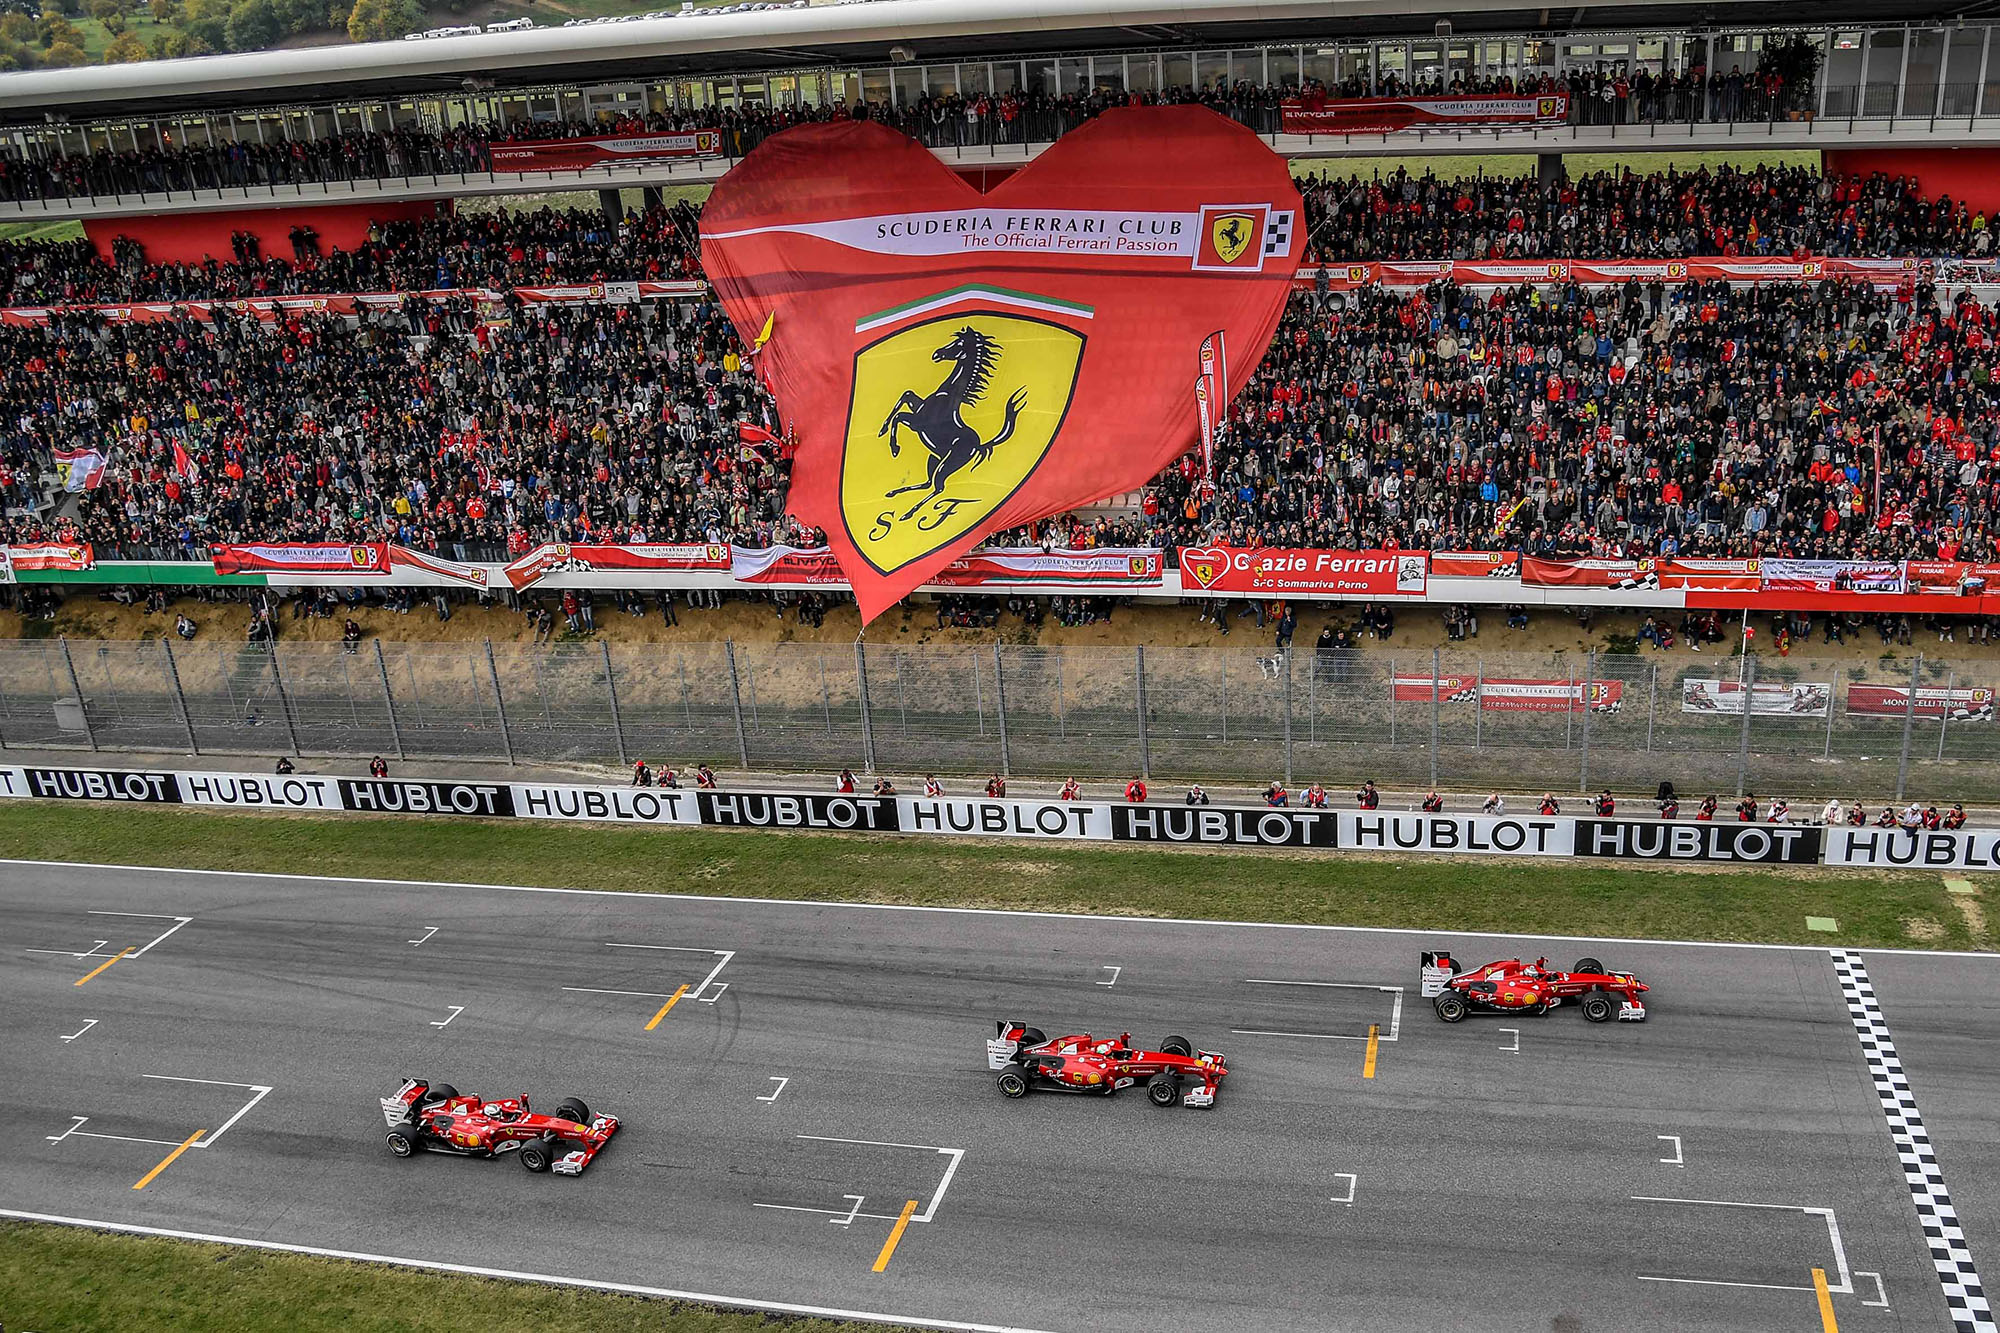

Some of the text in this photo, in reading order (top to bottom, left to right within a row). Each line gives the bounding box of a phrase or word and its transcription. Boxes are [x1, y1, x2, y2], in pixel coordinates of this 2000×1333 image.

[877, 216, 1182, 239] SCUDERIA FERRARI CLUB
[962, 234, 1178, 252] The Official Ferrari Passion
[868, 510, 895, 542] S
[1234, 552, 1396, 574] Gazie Ferrari
[1277, 579, 1334, 589] Sommariva
[1338, 580, 1368, 589] Perno
[1883, 699, 1935, 707] MONTCELLI
[34, 772, 164, 800] HUBLOT
[187, 774, 328, 807] HUBLOT
[350, 783, 498, 814] HUBLOT
[524, 788, 682, 821] HUBLOT
[713, 796, 881, 828] HUBLOT
[912, 802, 1094, 835] HUBLOT
[1128, 810, 1318, 844] HUBLOT
[1356, 815, 1556, 852] HUBLOT
[1593, 824, 1801, 861] HUBLOT
